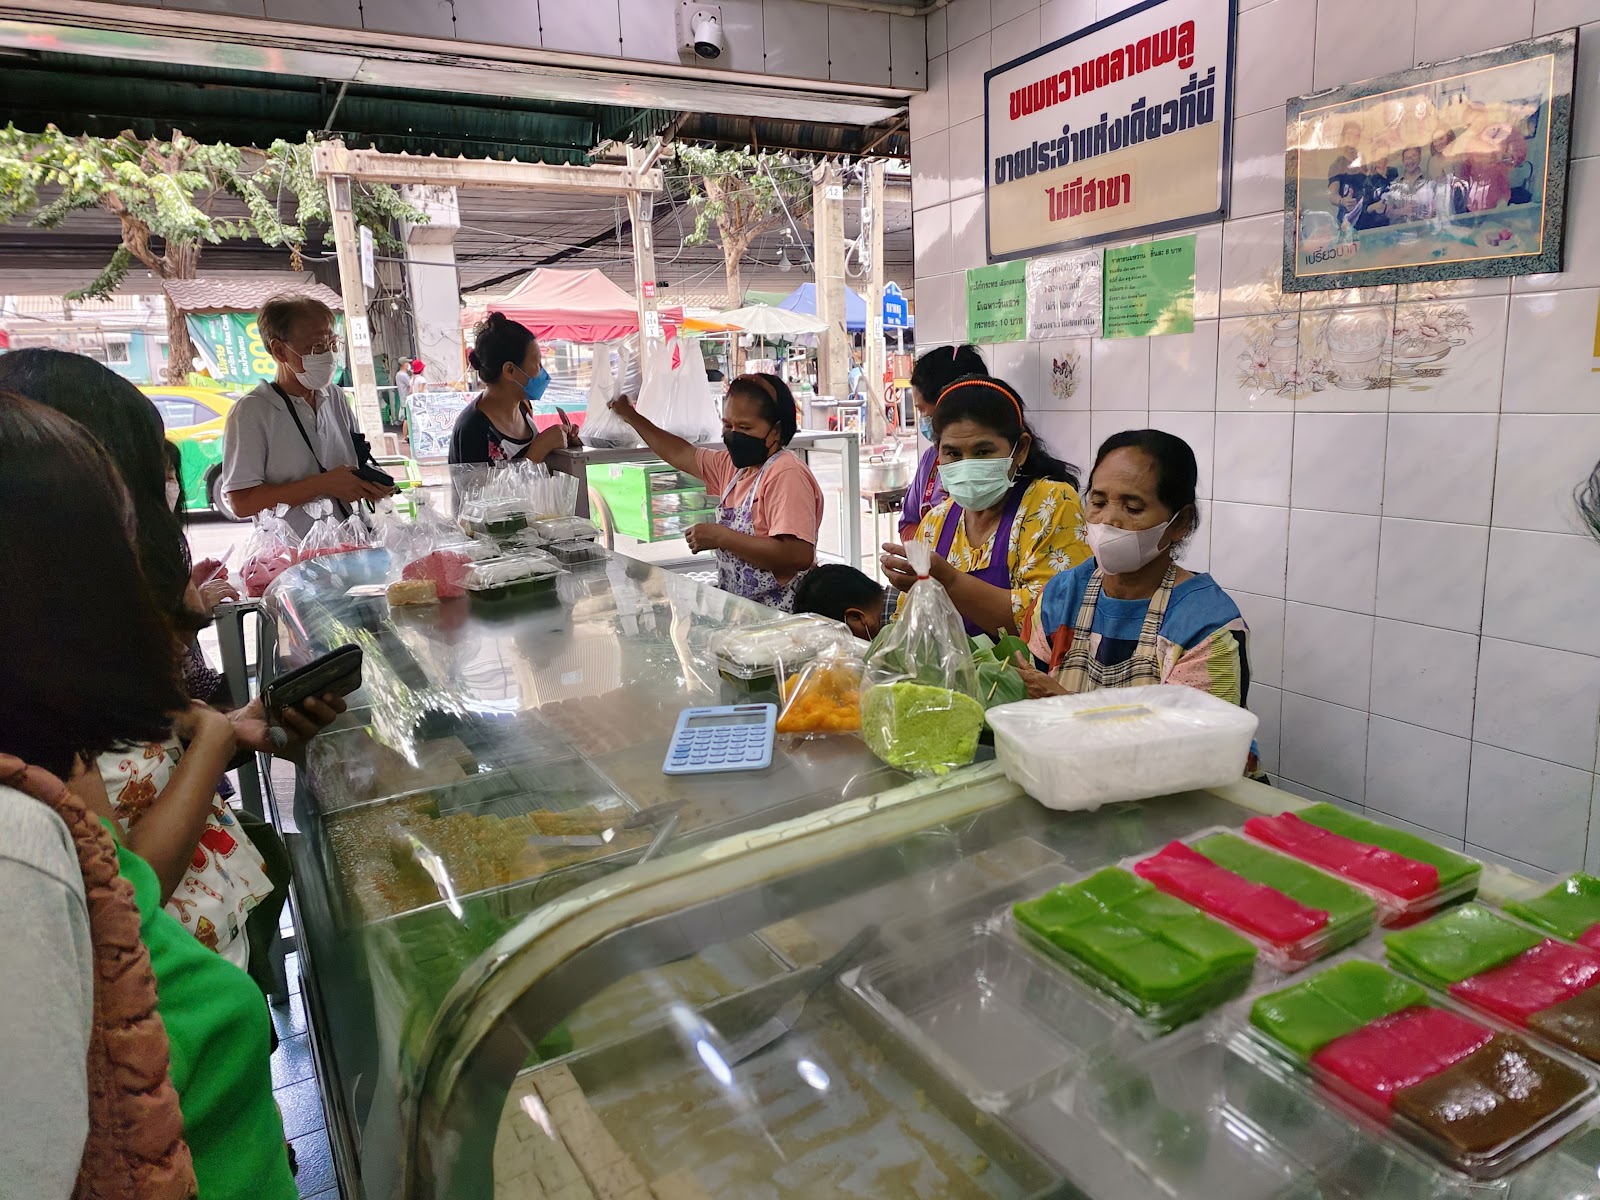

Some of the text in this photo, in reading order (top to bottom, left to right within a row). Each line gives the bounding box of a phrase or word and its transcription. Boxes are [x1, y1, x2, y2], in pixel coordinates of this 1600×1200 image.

[1009, 19, 1196, 121] ขนมหวานตลาดพลู
[994, 66, 1216, 185] ขายประจำแห่งเดียวที่นี่
[1045, 173, 1131, 222] ไม่มีสาขา
[1000, 318, 1008, 327] 10
